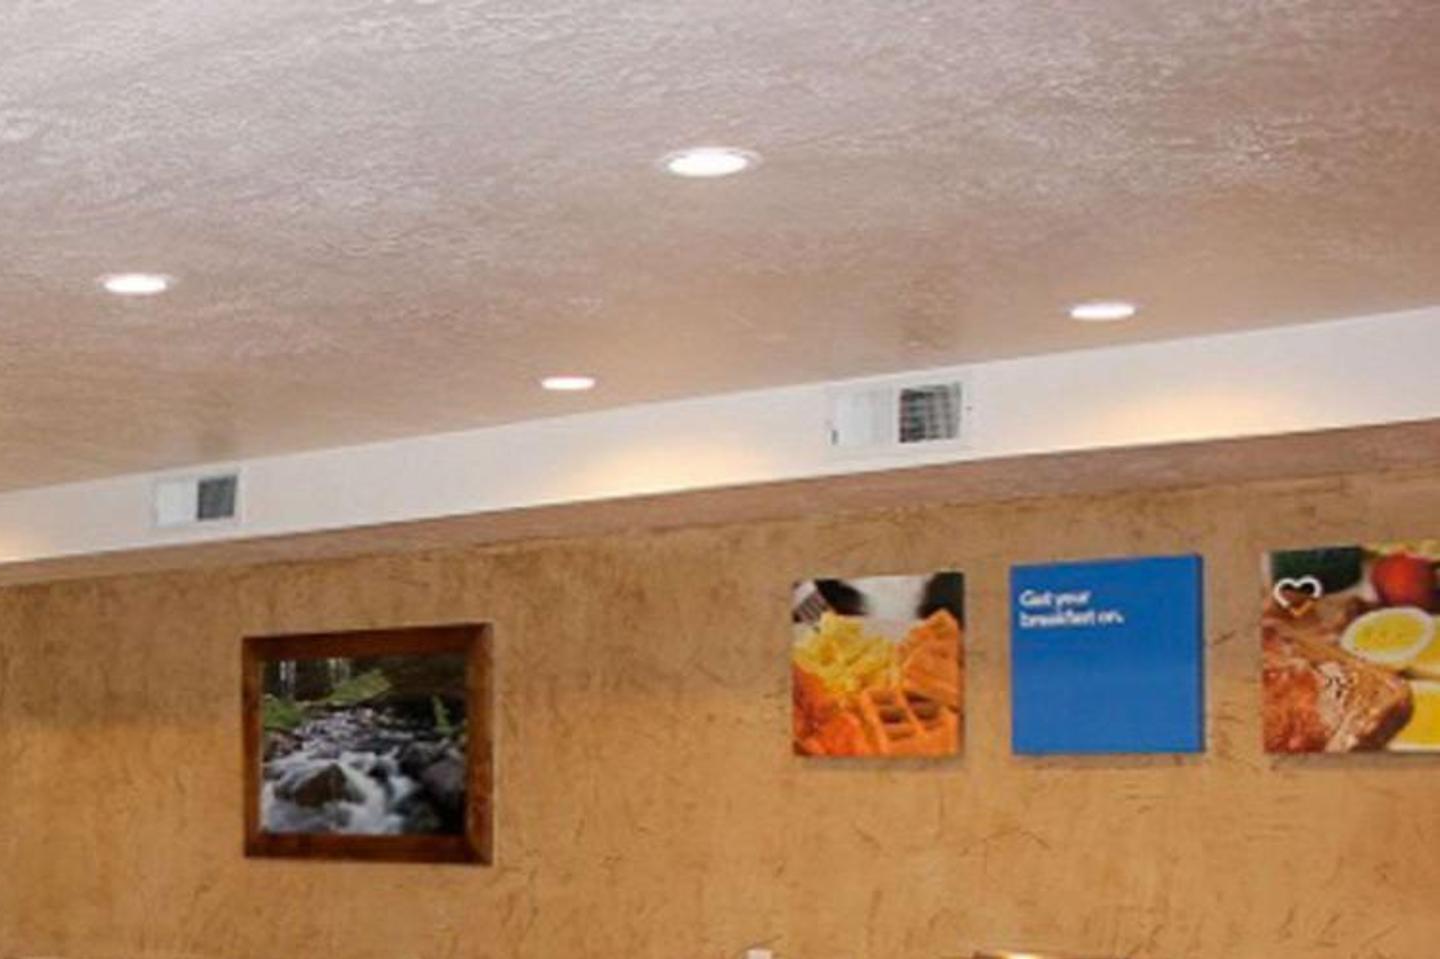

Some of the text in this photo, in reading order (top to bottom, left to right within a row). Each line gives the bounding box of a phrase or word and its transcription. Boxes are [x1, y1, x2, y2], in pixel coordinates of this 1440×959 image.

[1019, 589, 1092, 614] Get your
[1019, 610, 1095, 629] breakfast
